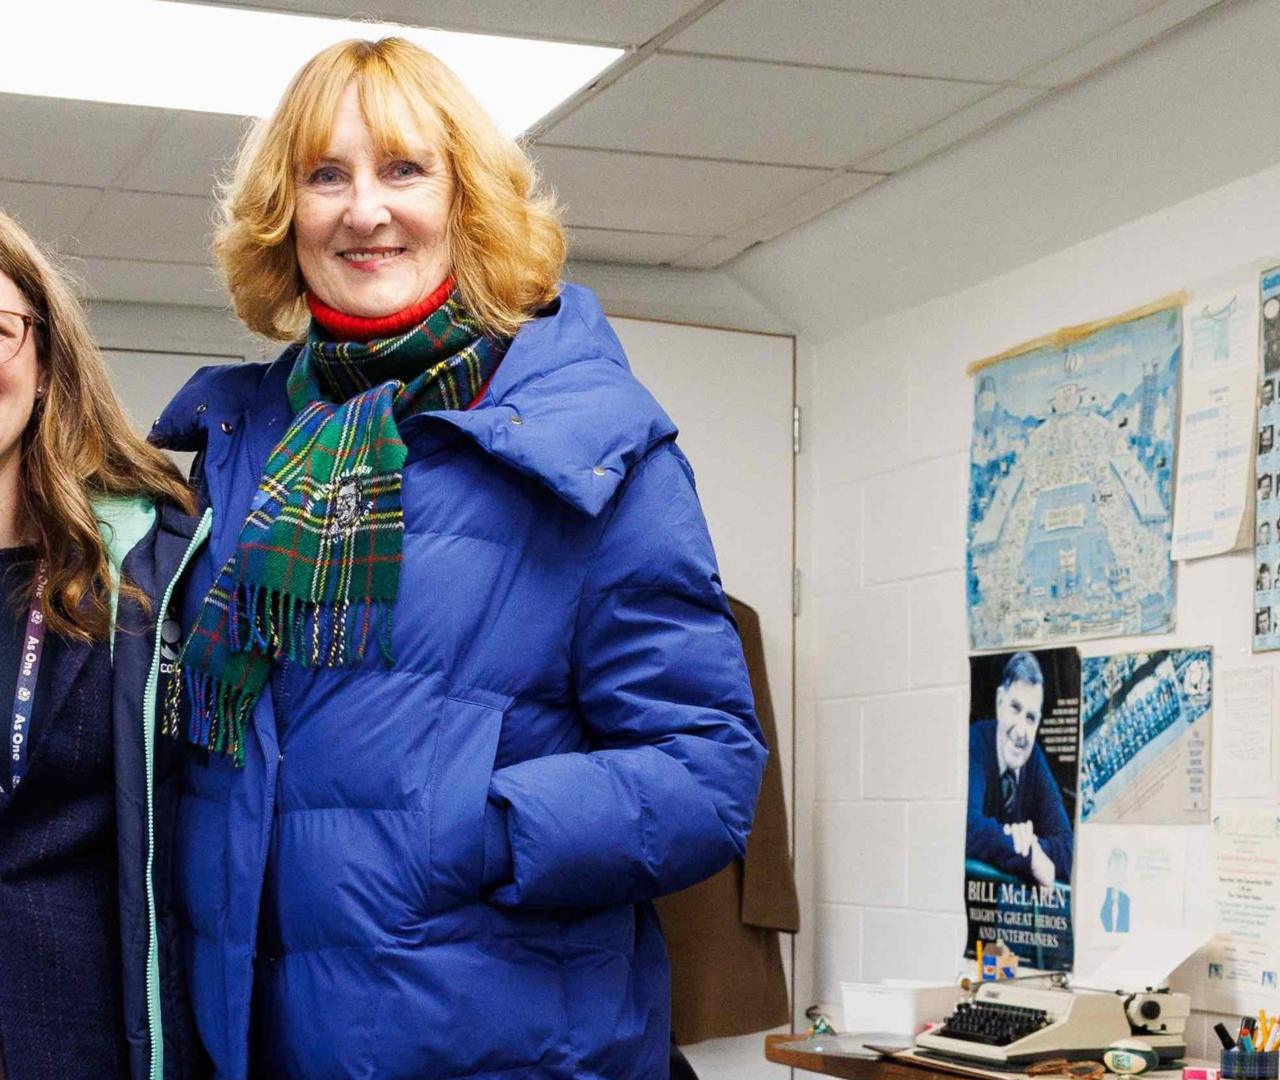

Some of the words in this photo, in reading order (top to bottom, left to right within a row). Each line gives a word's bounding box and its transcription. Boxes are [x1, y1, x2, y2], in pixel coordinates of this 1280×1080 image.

[28, 635, 40, 652] As
[22, 653, 37, 676] One
[14, 713, 26, 730] As
[12, 731, 24, 761] One
[968, 880, 996, 903] BILL
[1001, 883, 1067, 909] McLAREN
[970, 907, 1002, 925] RUGBY'S
[1005, 910, 1033, 927] GREAT
[1035, 912, 1067, 931] HEROES
[979, 925, 996, 940] AND
[998, 926, 1058, 949] ENTERTAINERS
